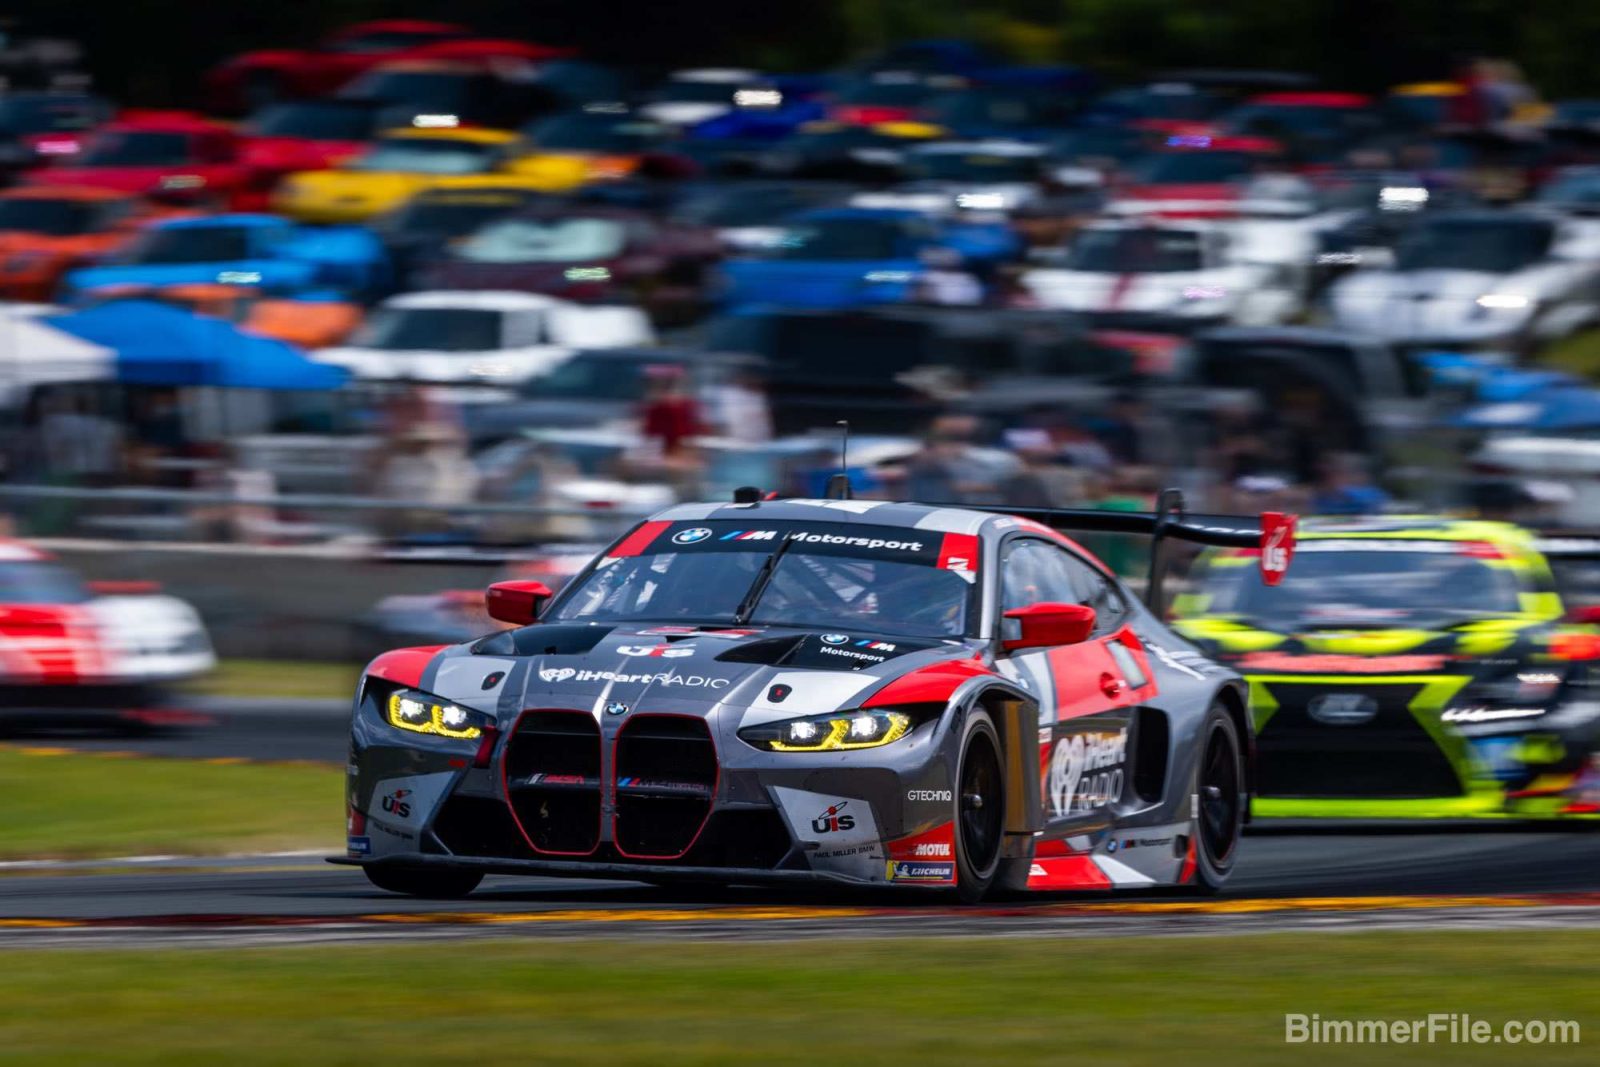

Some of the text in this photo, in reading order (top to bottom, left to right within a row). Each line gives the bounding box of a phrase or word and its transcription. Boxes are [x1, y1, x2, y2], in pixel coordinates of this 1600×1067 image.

[783, 531, 924, 552] Motorsport
[820, 646, 885, 662] Motorsport
[908, 789, 952, 802] GTECHNIQ
[832, 848, 857, 858] MILLER
[858, 845, 875, 855] BMW
[915, 843, 951, 856] MOTUL
